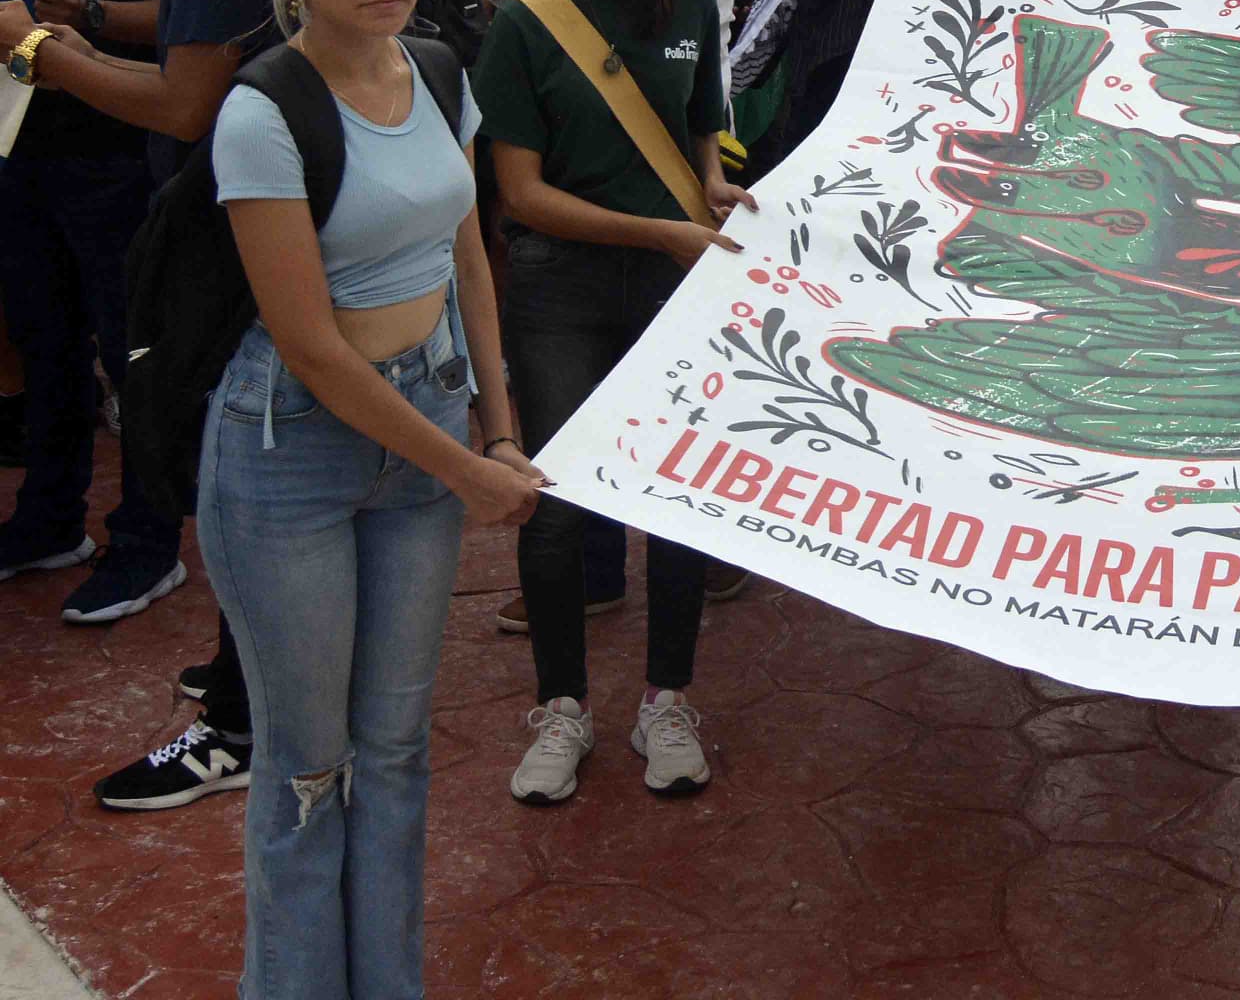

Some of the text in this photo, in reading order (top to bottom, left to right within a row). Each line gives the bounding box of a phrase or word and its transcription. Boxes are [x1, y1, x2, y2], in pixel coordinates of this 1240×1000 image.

[664, 47, 685, 59] Pollo
[642, 485, 727, 518] LAS
[736, 515, 919, 586] BOMBAS
[930, 578, 993, 606] NO
[1004, 596, 1219, 645] MATARÁN
[656, 430, 983, 568] LIBERTAD
[994, 526, 1174, 607] PARA
